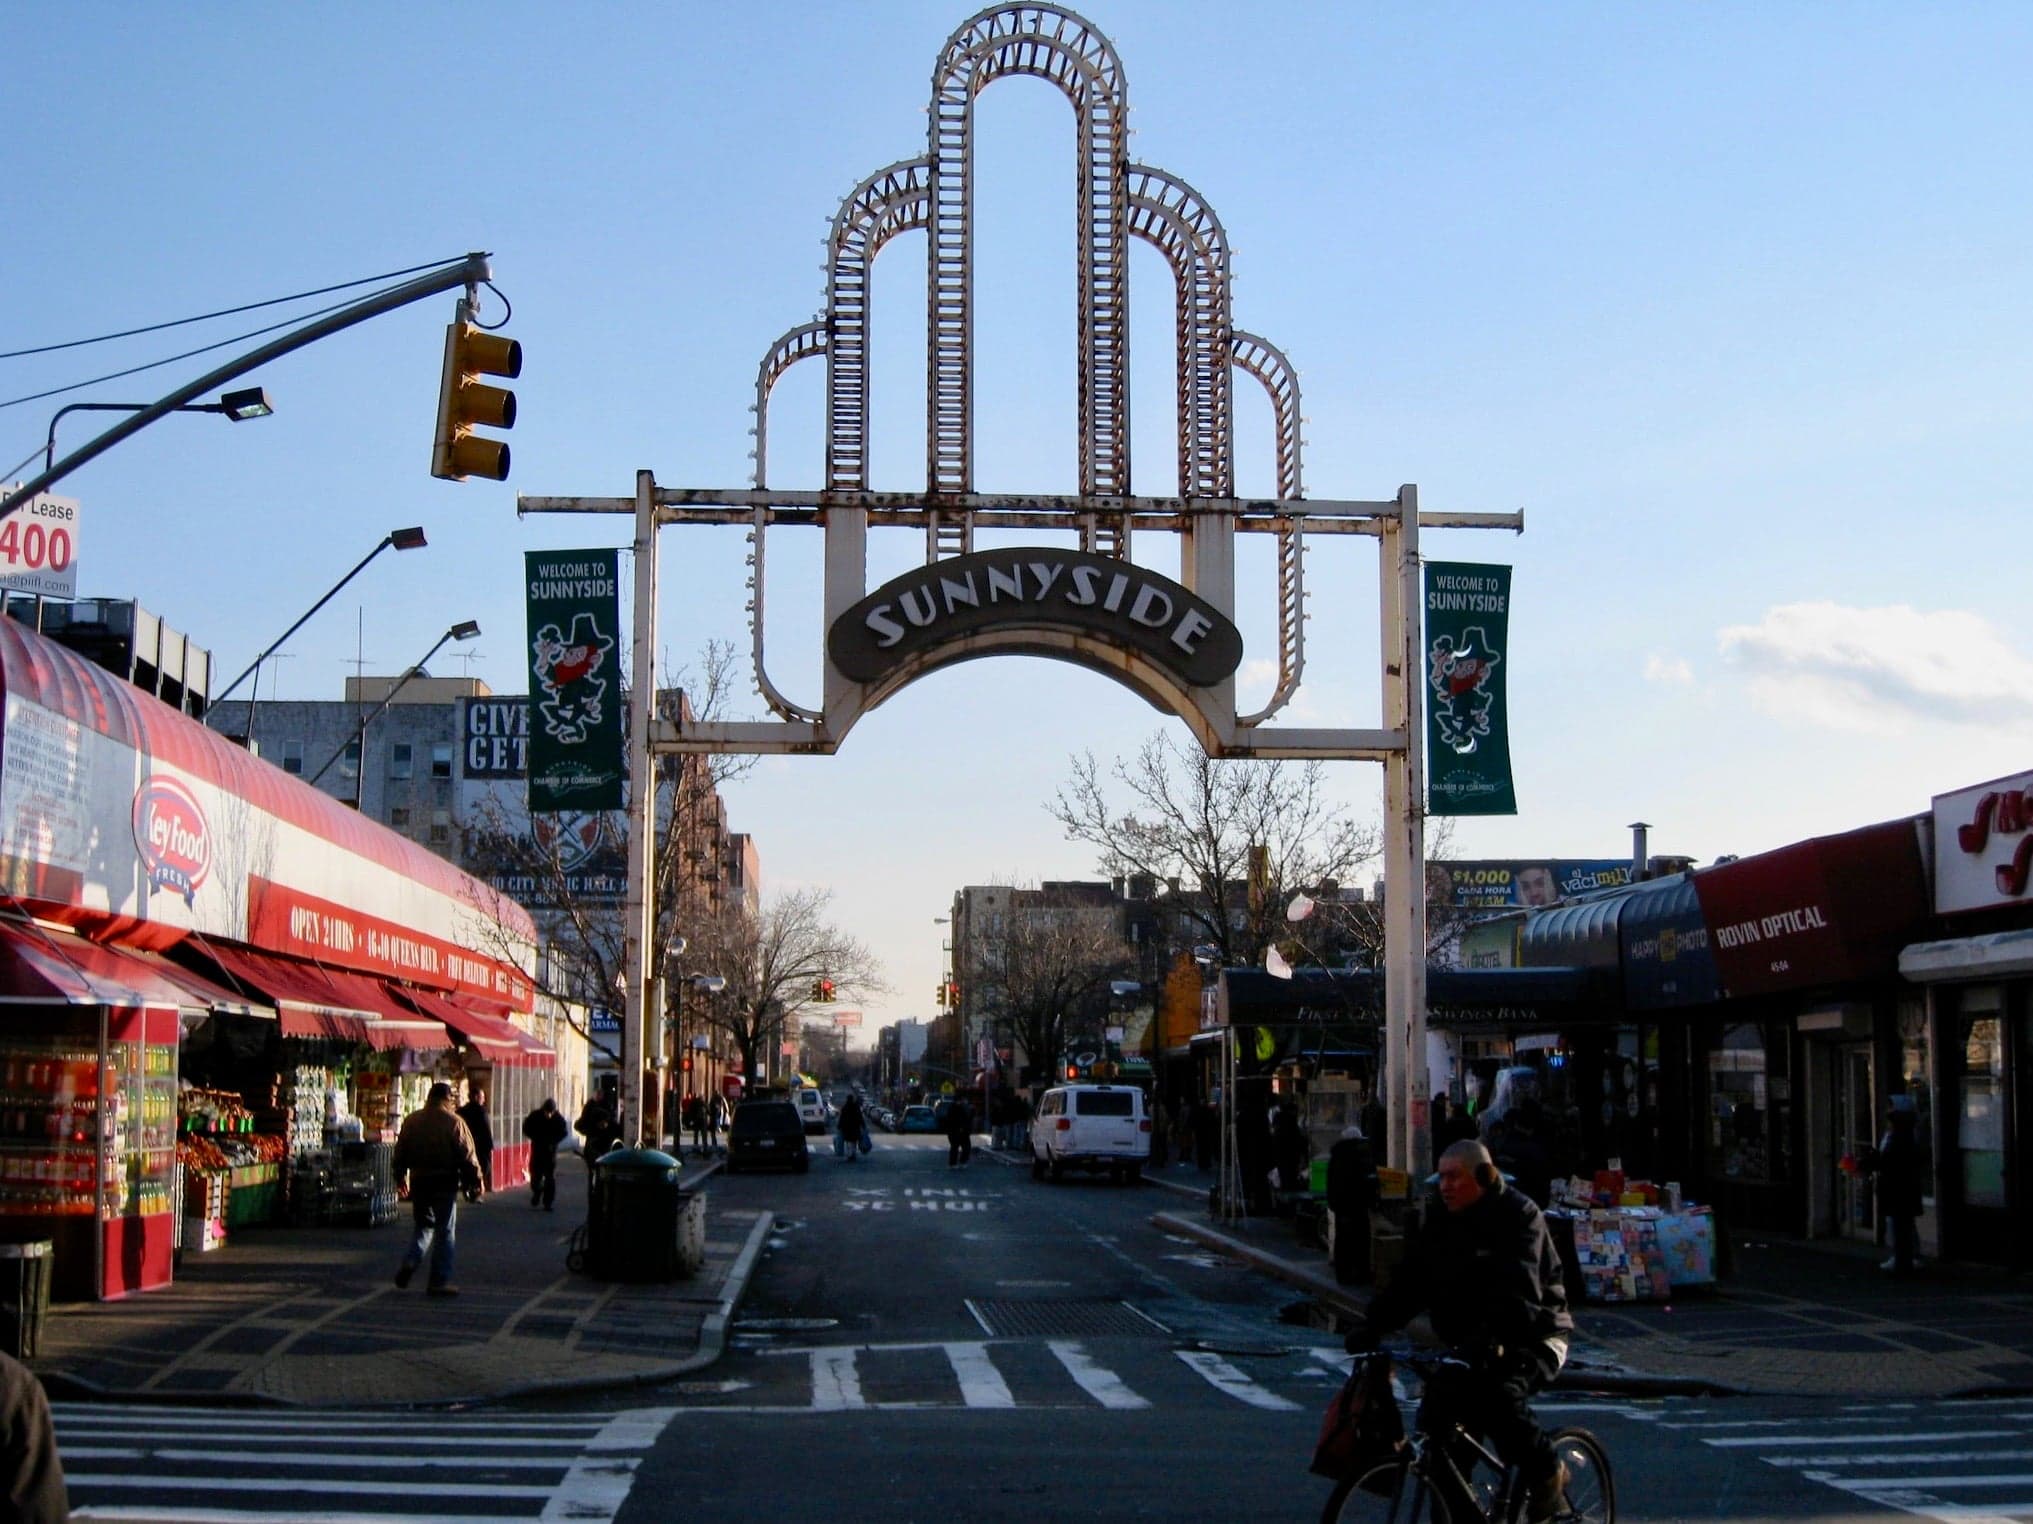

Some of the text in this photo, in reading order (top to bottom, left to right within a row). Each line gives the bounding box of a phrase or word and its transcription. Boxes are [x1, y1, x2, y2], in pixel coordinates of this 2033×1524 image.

[32, 496, 74, 520] Lease
[0, 520, 71, 573] 400
[538, 562, 606, 579] WELCOME TO
[530, 579, 615, 600] SUNNYSIDE
[1436, 575, 1499, 592] WELCOME TO
[865, 562, 1213, 655] SUNNYSIDE
[1428, 591, 1505, 613] SUNNYSIDE
[469, 736, 529, 770] GET
[171, 815, 205, 865] Food
[1485, 885, 1512, 896] HORA
[291, 903, 320, 945] OPEN
[1716, 904, 1828, 950] ROVIN OPTICAL
[1676, 927, 1708, 952] PHOTO
